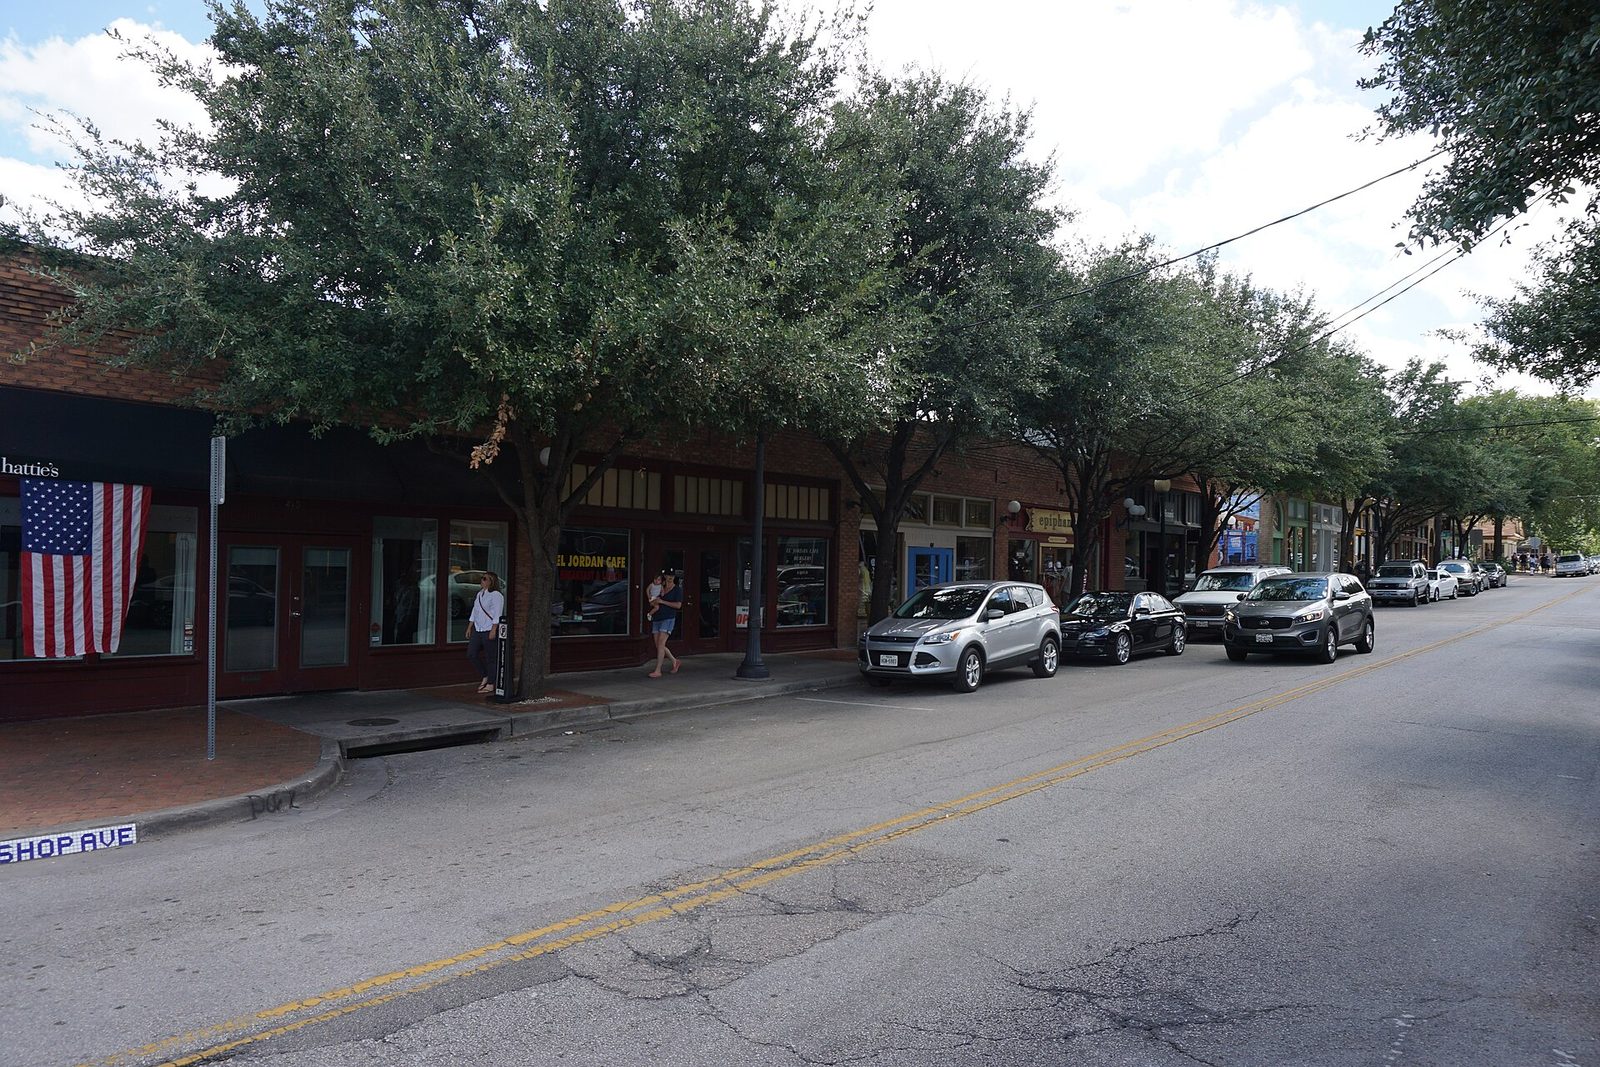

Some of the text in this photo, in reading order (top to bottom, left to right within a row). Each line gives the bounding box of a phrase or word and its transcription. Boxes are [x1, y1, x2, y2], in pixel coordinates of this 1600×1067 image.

[1, 456, 59, 477] hattie's
[1039, 513, 1071, 530] epiphan
[555, 554, 626, 568] EL JORDAN CAFE
[81, 827, 133, 852] AVE
